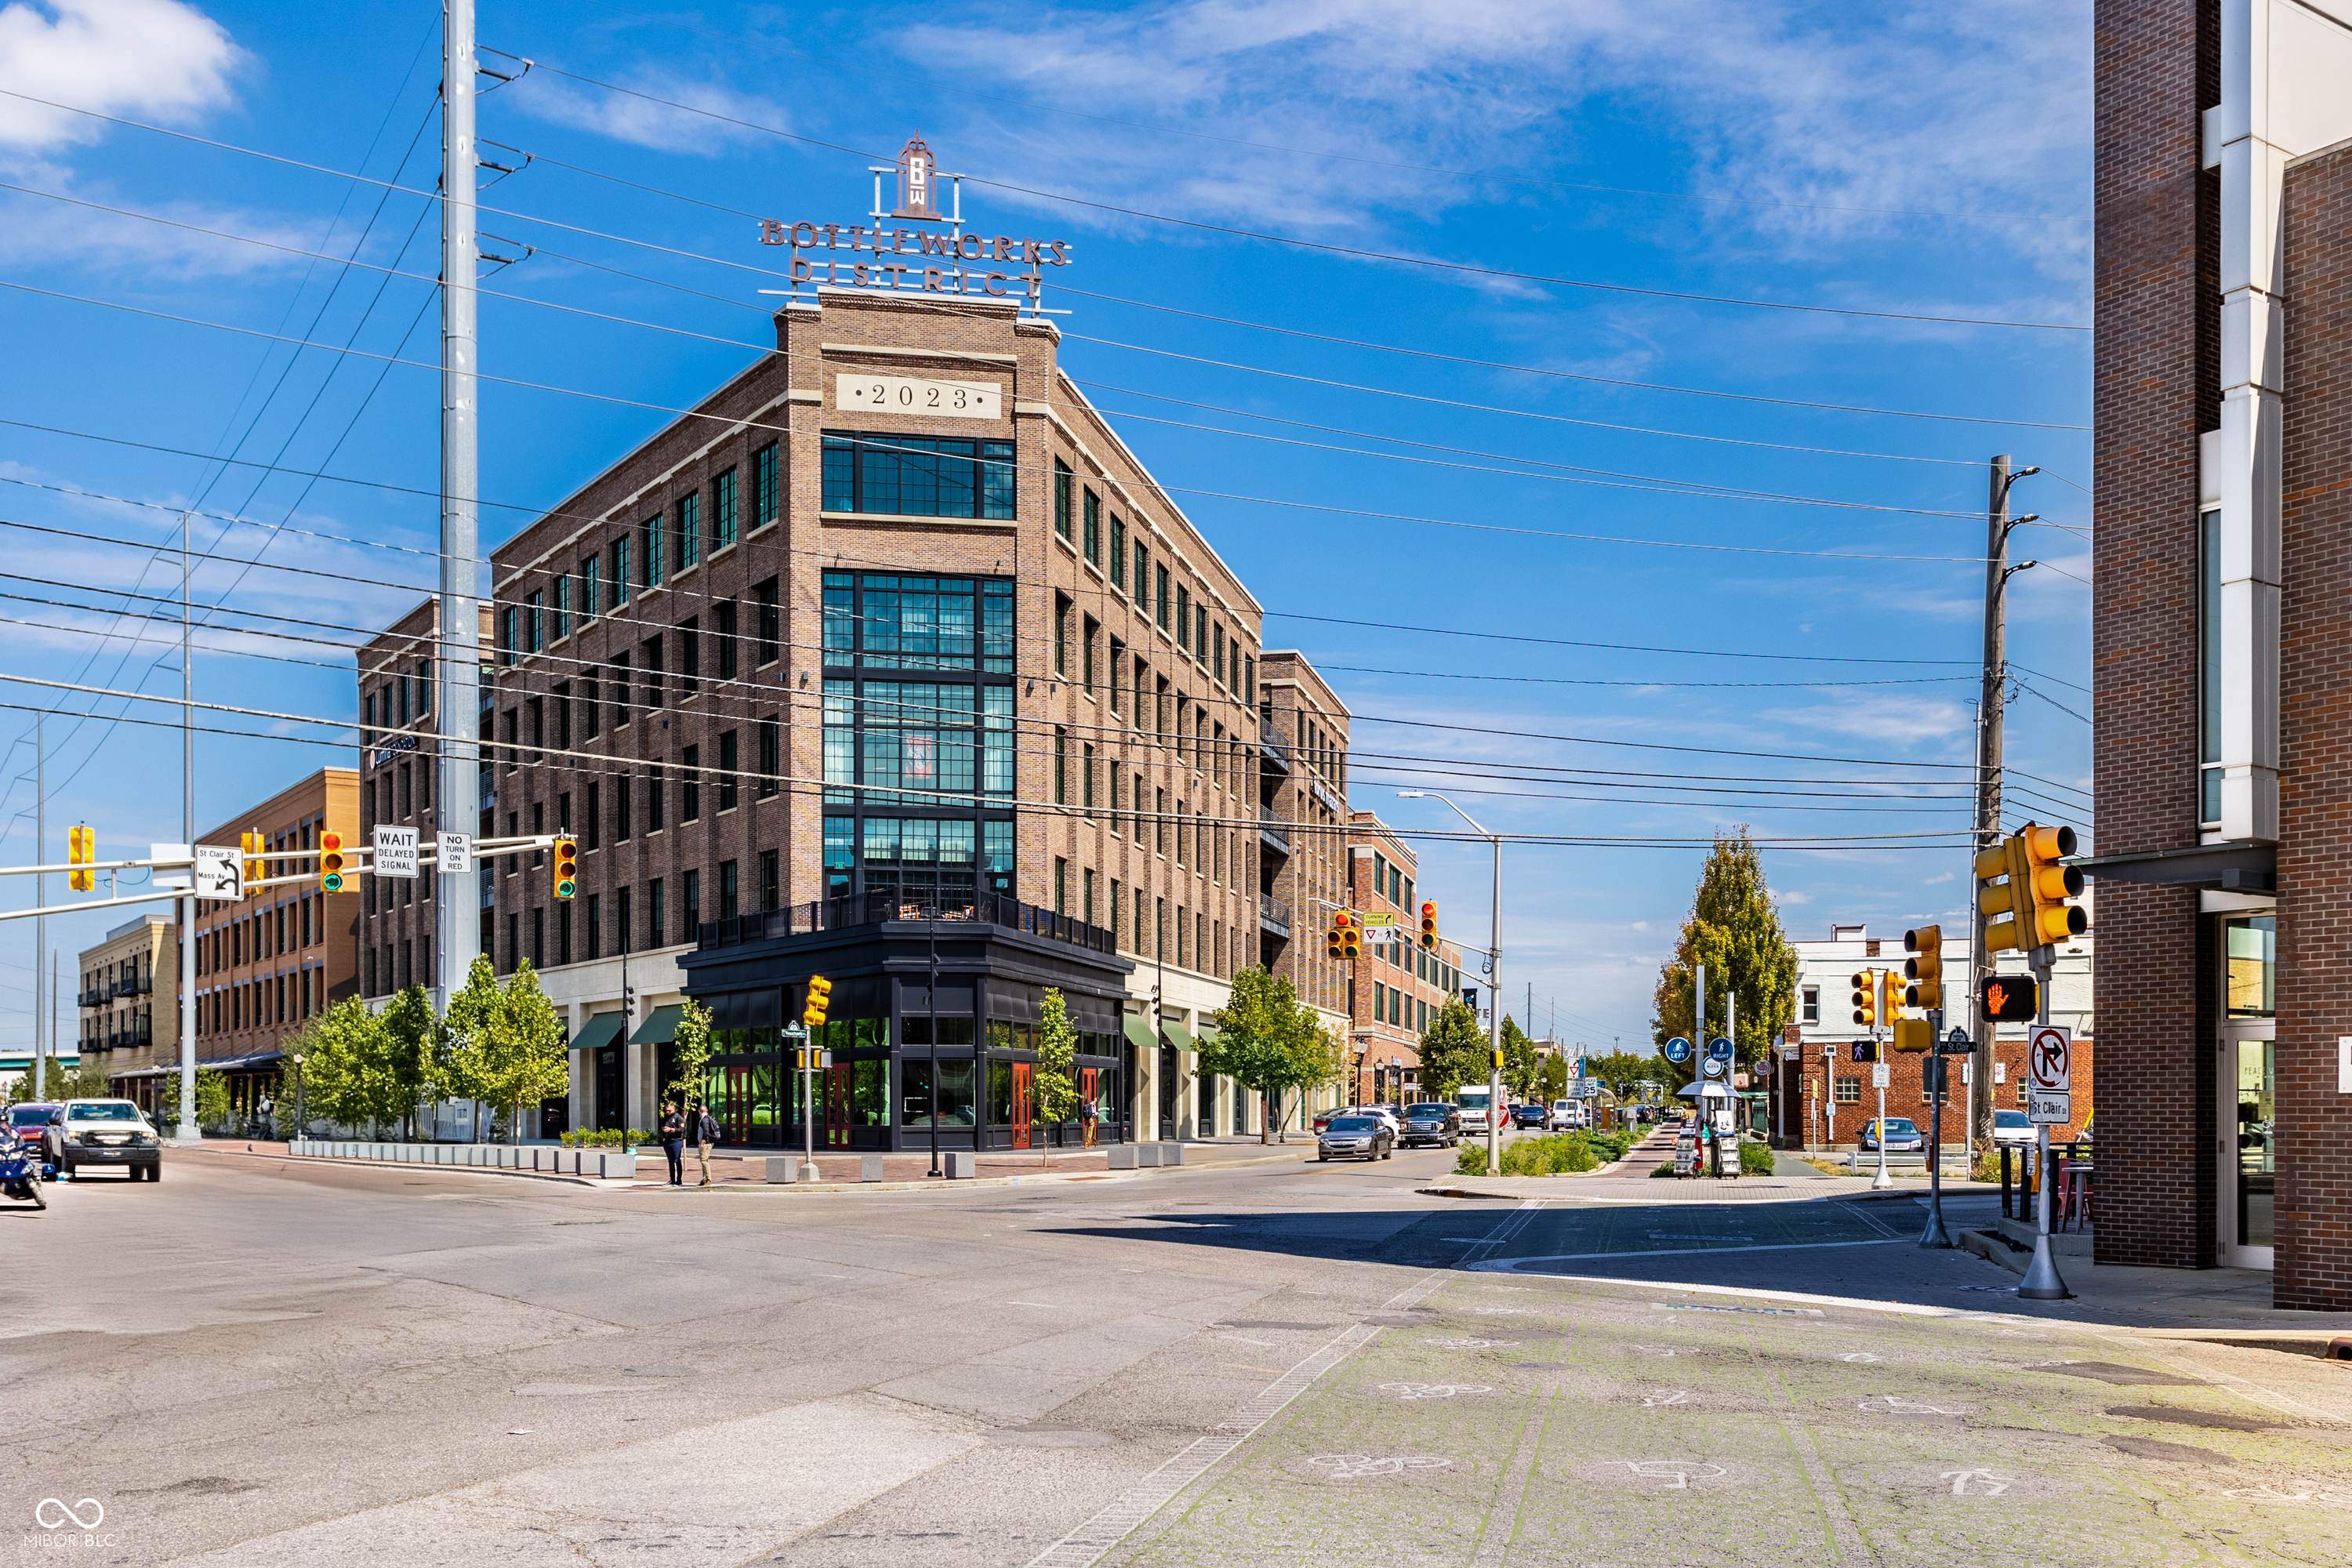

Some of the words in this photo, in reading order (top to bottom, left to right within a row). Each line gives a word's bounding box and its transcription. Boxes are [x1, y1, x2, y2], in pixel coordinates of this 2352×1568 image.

[763, 219, 1067, 267] BOTTLEWORKS
[789, 256, 1042, 299] DISTRICT
[872, 384, 967, 408] 2023
[379, 833, 413, 846] WAIT
[447, 836, 463, 844] NO
[379, 848, 414, 858] DELAYED
[381, 861, 412, 870] SIGNAL
[1956, 1042, 1969, 1051] Clair
[2043, 1101, 2062, 1115] Clair
